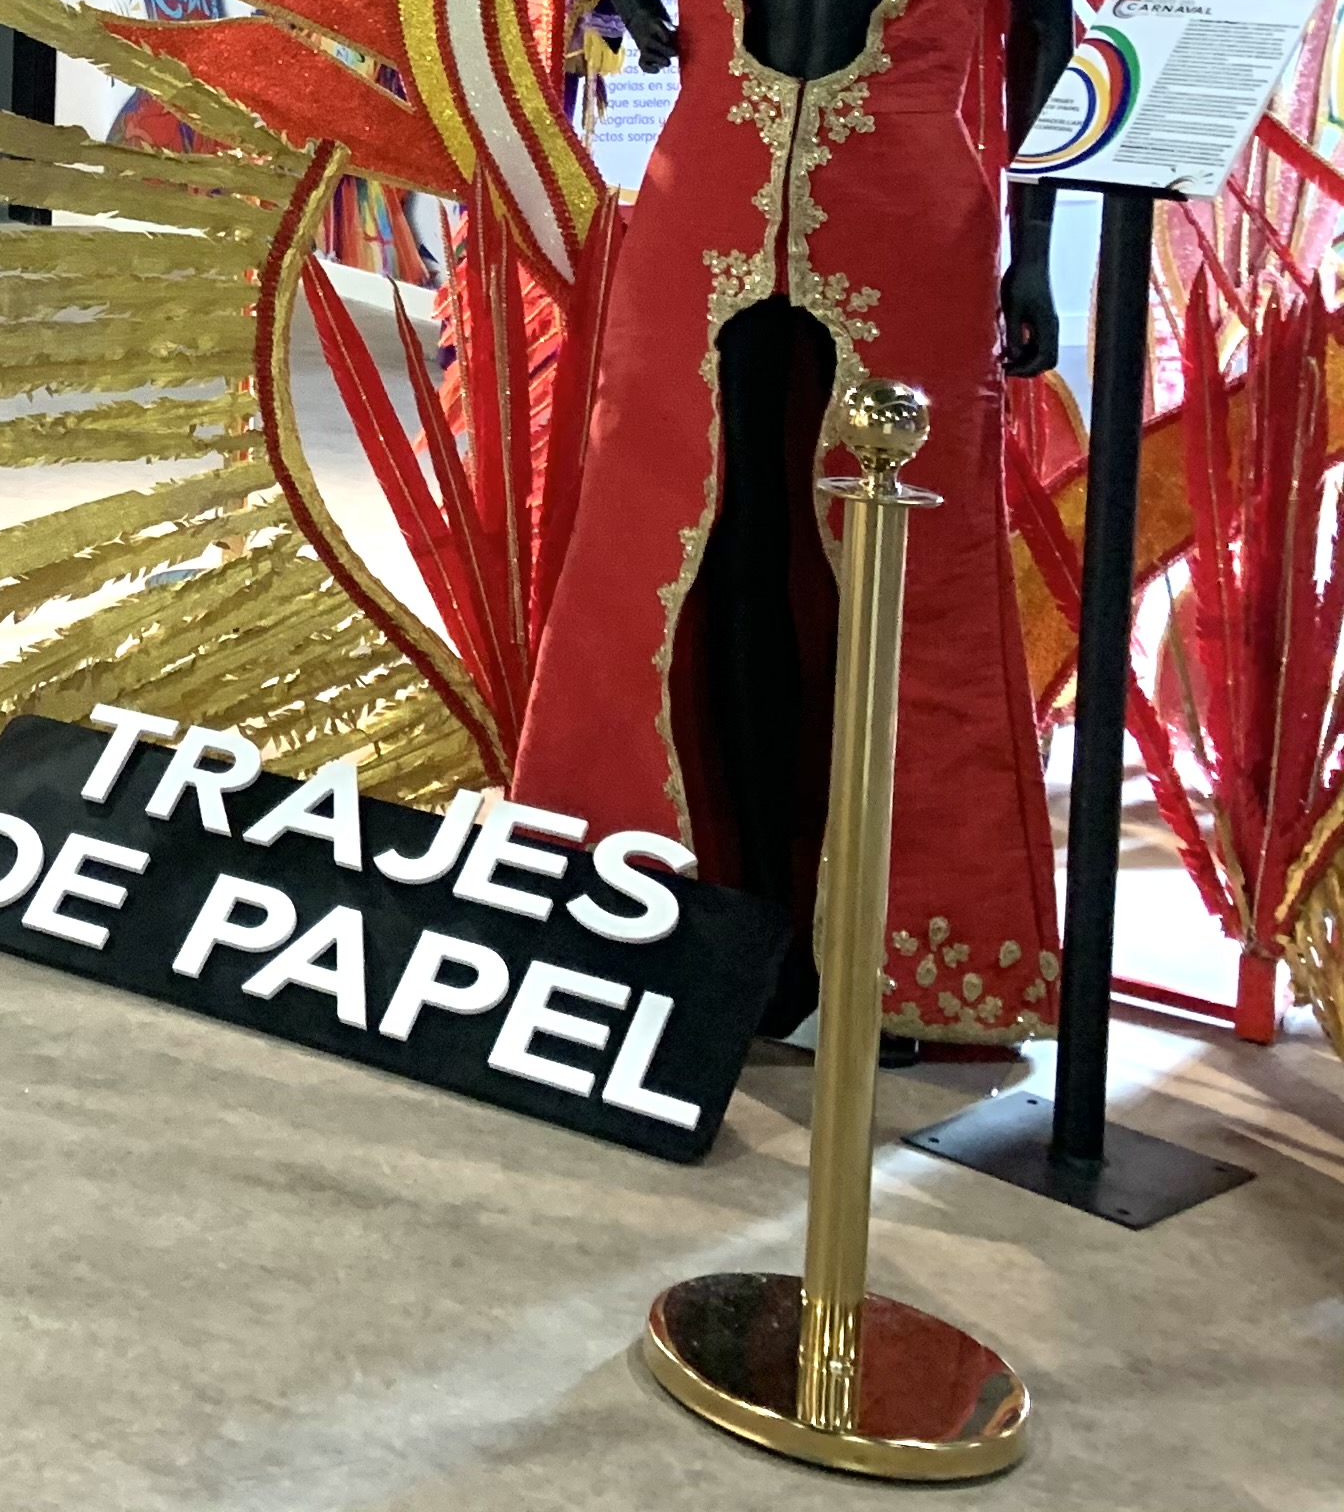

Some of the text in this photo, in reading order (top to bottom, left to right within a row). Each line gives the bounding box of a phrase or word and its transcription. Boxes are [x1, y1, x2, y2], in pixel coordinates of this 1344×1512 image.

[1127, 2, 1212, 15] CARNAVAL
[648, 83, 662, 91] en
[633, 98, 670, 108] suelen
[81, 704, 698, 944] TRAJES
[172, 874, 701, 1130] PAPEL
